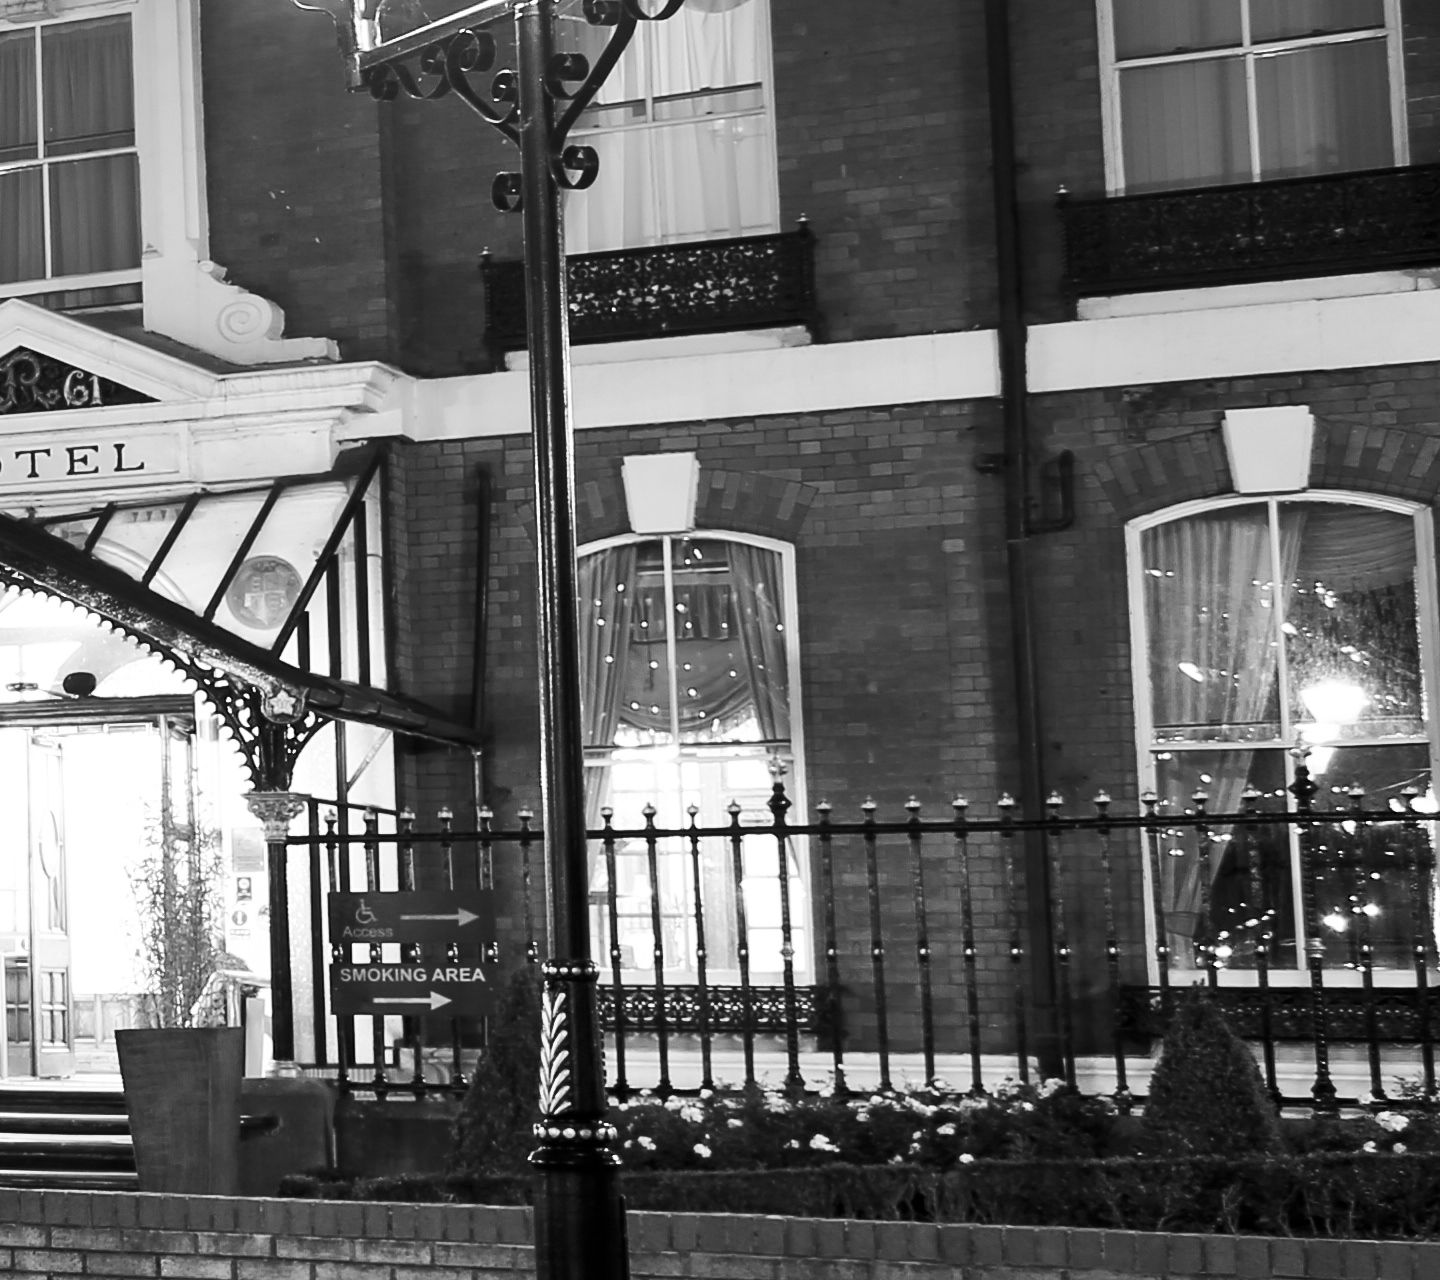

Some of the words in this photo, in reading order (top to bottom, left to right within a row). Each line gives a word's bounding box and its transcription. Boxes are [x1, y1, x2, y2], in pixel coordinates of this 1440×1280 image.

[63, 369, 103, 407] 61
[342, 925, 394, 938] Access
[340, 967, 427, 983] SMOKING
[431, 967, 487, 983] AREA
